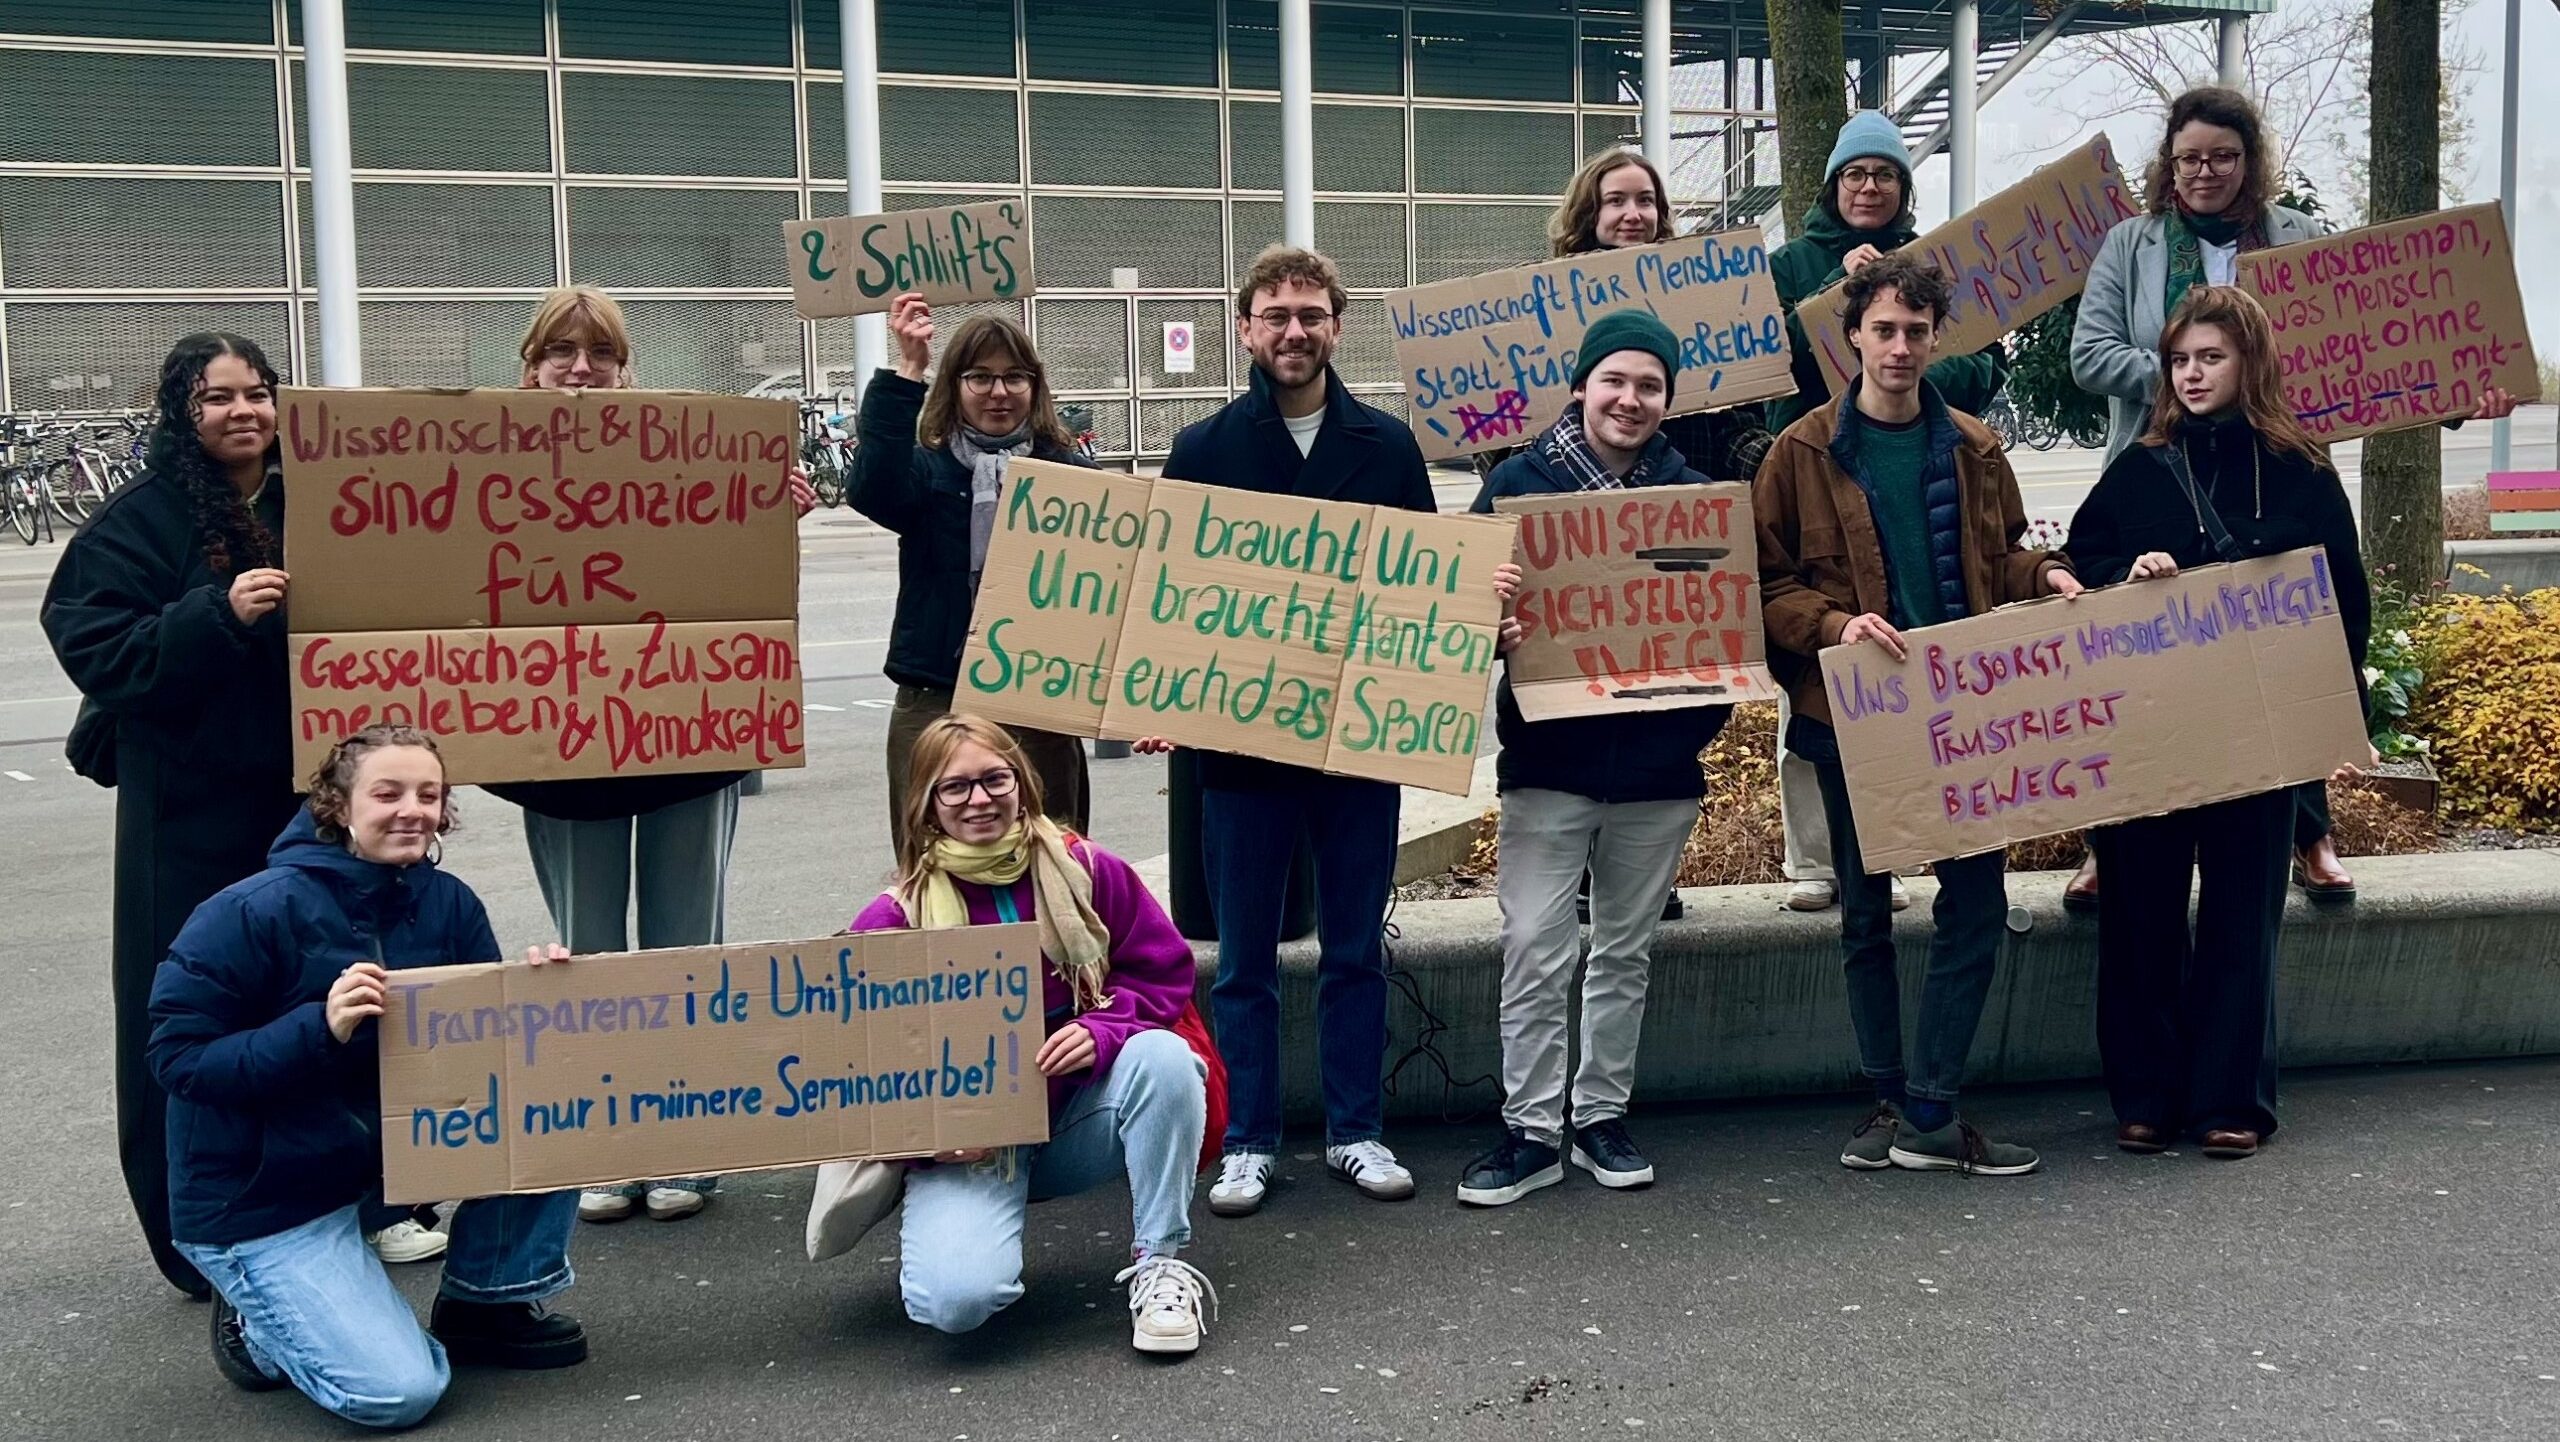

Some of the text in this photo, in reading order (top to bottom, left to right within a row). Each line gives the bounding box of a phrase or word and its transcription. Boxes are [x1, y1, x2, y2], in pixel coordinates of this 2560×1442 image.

[2255, 218, 2491, 298] Wie versteht man,
[2333, 264, 2454, 319] Mensch
[2382, 301, 2486, 348] ohne
[289, 401, 791, 510] Wissenschaft & Bildung
[329, 461, 459, 537] sind
[1007, 476, 1465, 595] Kanton braucht Uni
[1520, 498, 1734, 572] UNI SPART
[1027, 547, 1495, 676] Uni braucht Kanton
[1514, 569, 1754, 641] SICH SELBST
[300, 620, 636, 694] Gessellschaft,
[968, 617, 1109, 706] Spart
[1339, 675, 1480, 756] Sparen
[301, 686, 804, 773] menleben & Demokratie
[1927, 690, 2126, 768] FRUSTRIERT
[1941, 752, 2113, 824] BEWEGT
[387, 947, 1029, 1068] Transparenz i de Unifinanzierig
[411, 1072, 500, 1149] ned
[522, 1090, 595, 1136] nur
[602, 1073, 618, 1125] i
